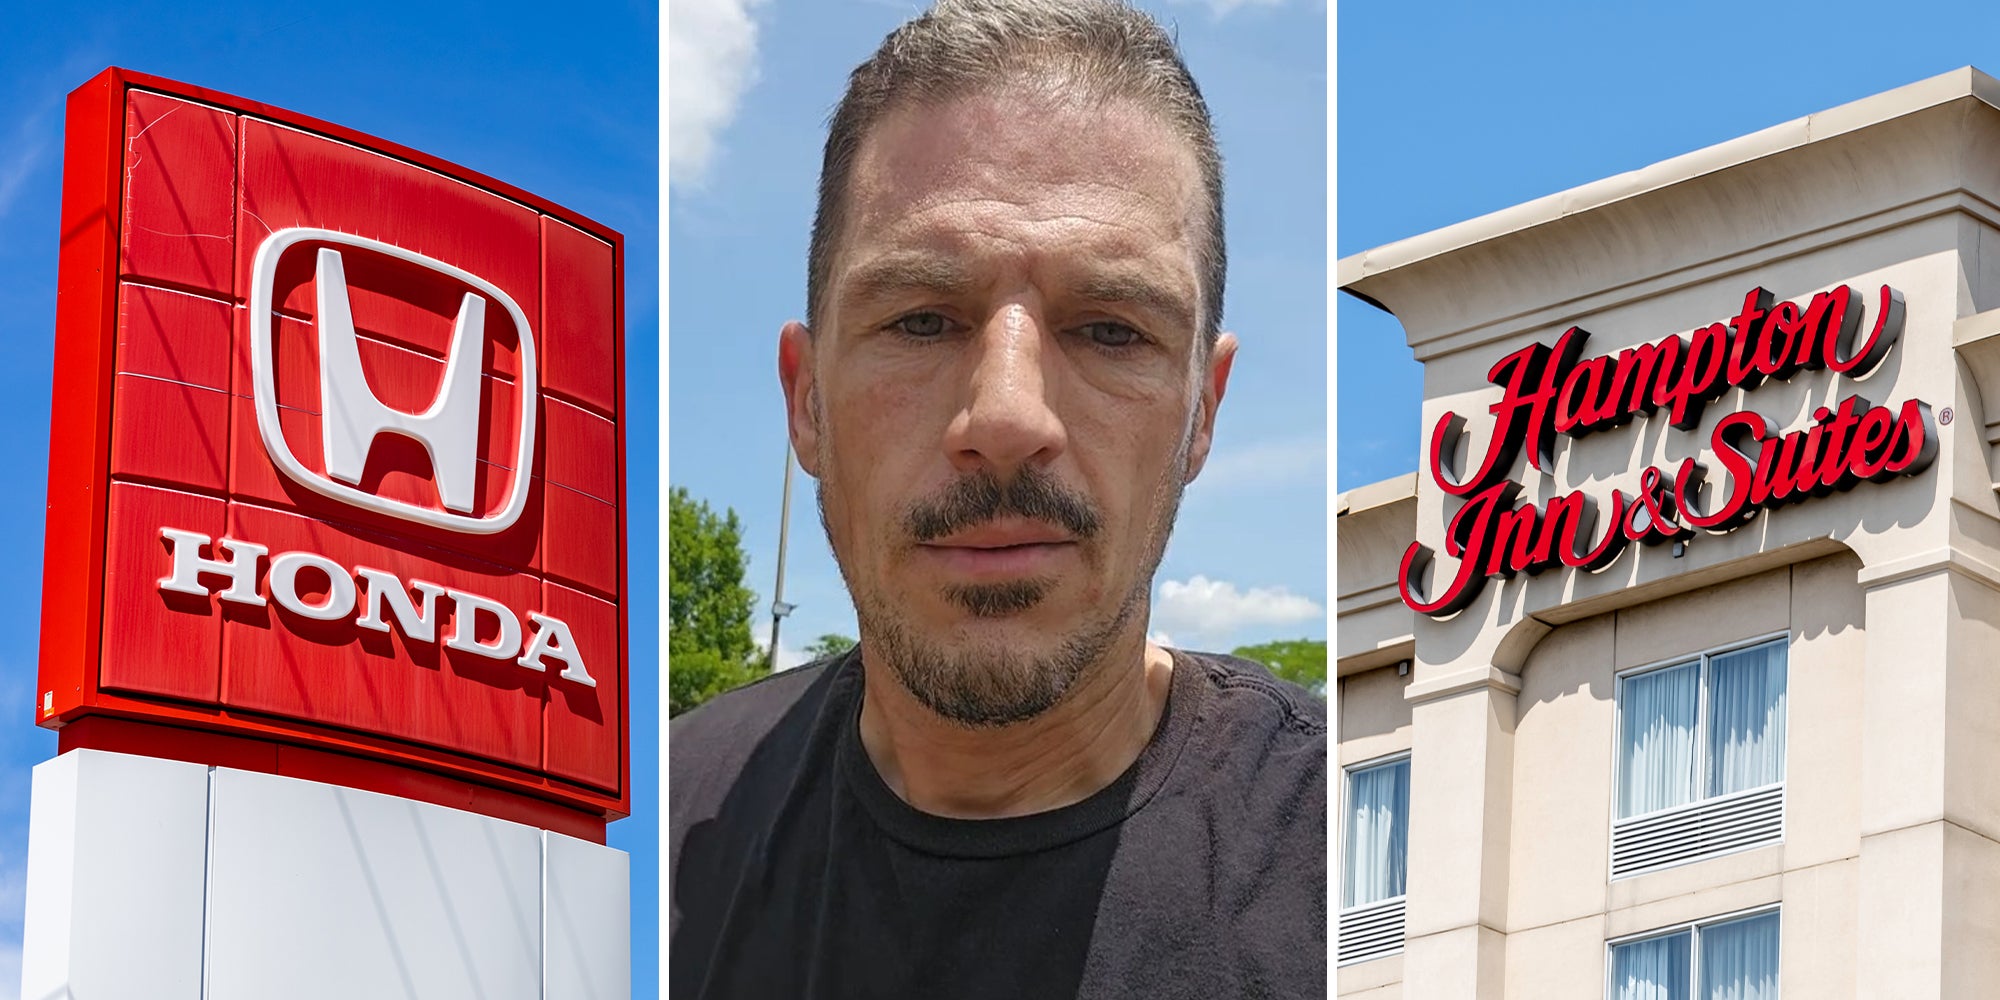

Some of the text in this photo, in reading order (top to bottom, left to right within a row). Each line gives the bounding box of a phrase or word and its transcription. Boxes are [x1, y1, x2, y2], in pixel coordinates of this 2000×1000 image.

[1430, 284, 1892, 496] Hampton
[159, 527, 597, 688] HONDA
[1398, 479, 1623, 614] Inn
[1623, 466, 1680, 541] &
[1676, 396, 1924, 527] Suites
